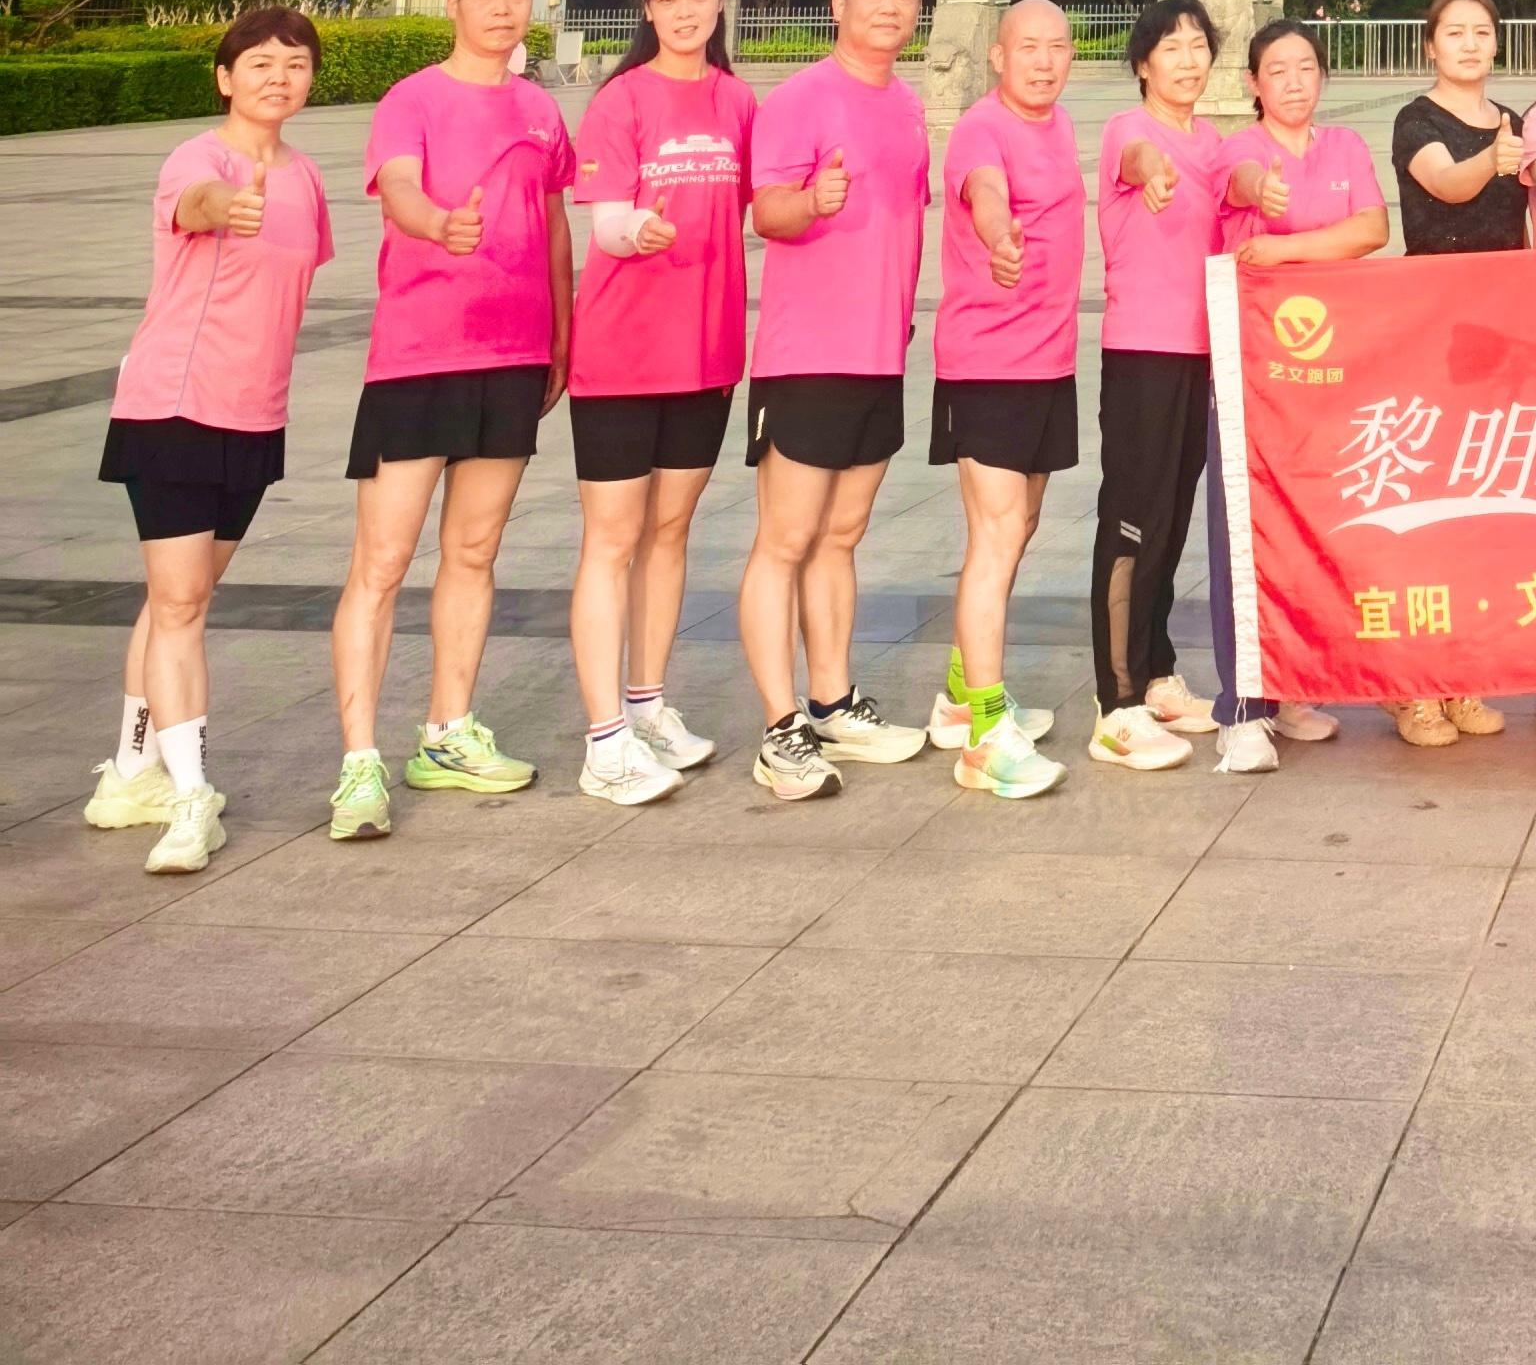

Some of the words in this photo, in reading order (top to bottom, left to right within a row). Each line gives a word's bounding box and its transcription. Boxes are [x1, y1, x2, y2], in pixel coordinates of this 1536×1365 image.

[640, 159, 697, 180] Rock
[650, 175, 706, 188] RUNNING
[1267, 360, 1345, 385] 艺文跑团
[132, 706, 150, 755] SPORT
